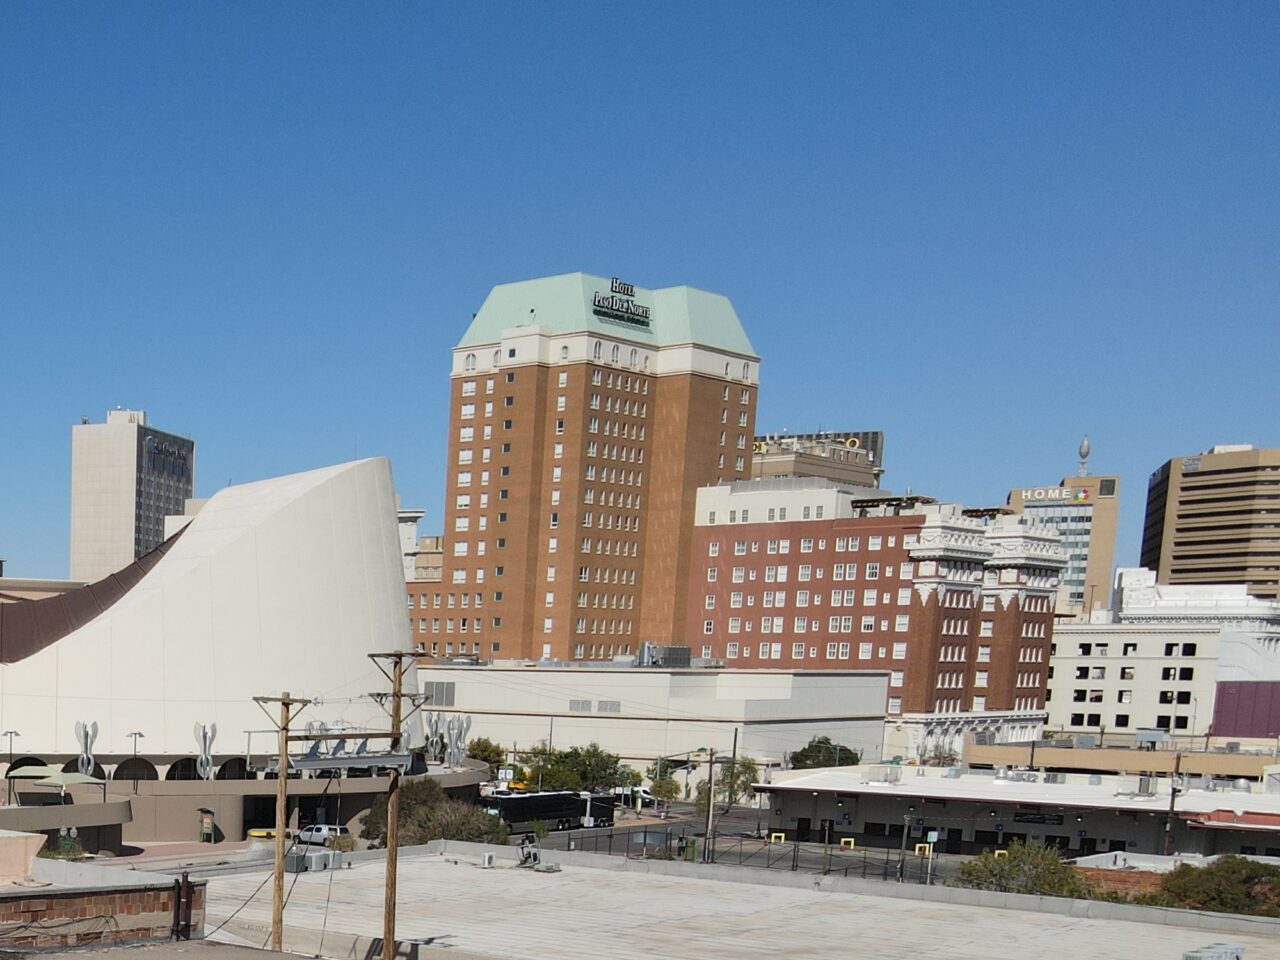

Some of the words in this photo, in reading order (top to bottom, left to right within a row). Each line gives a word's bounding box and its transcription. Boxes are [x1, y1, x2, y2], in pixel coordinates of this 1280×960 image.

[612, 278, 635, 295] HOTEL
[594, 292, 612, 307] PASO
[628, 300, 650, 317] NORTE
[1022, 489, 1071, 500] HOME
